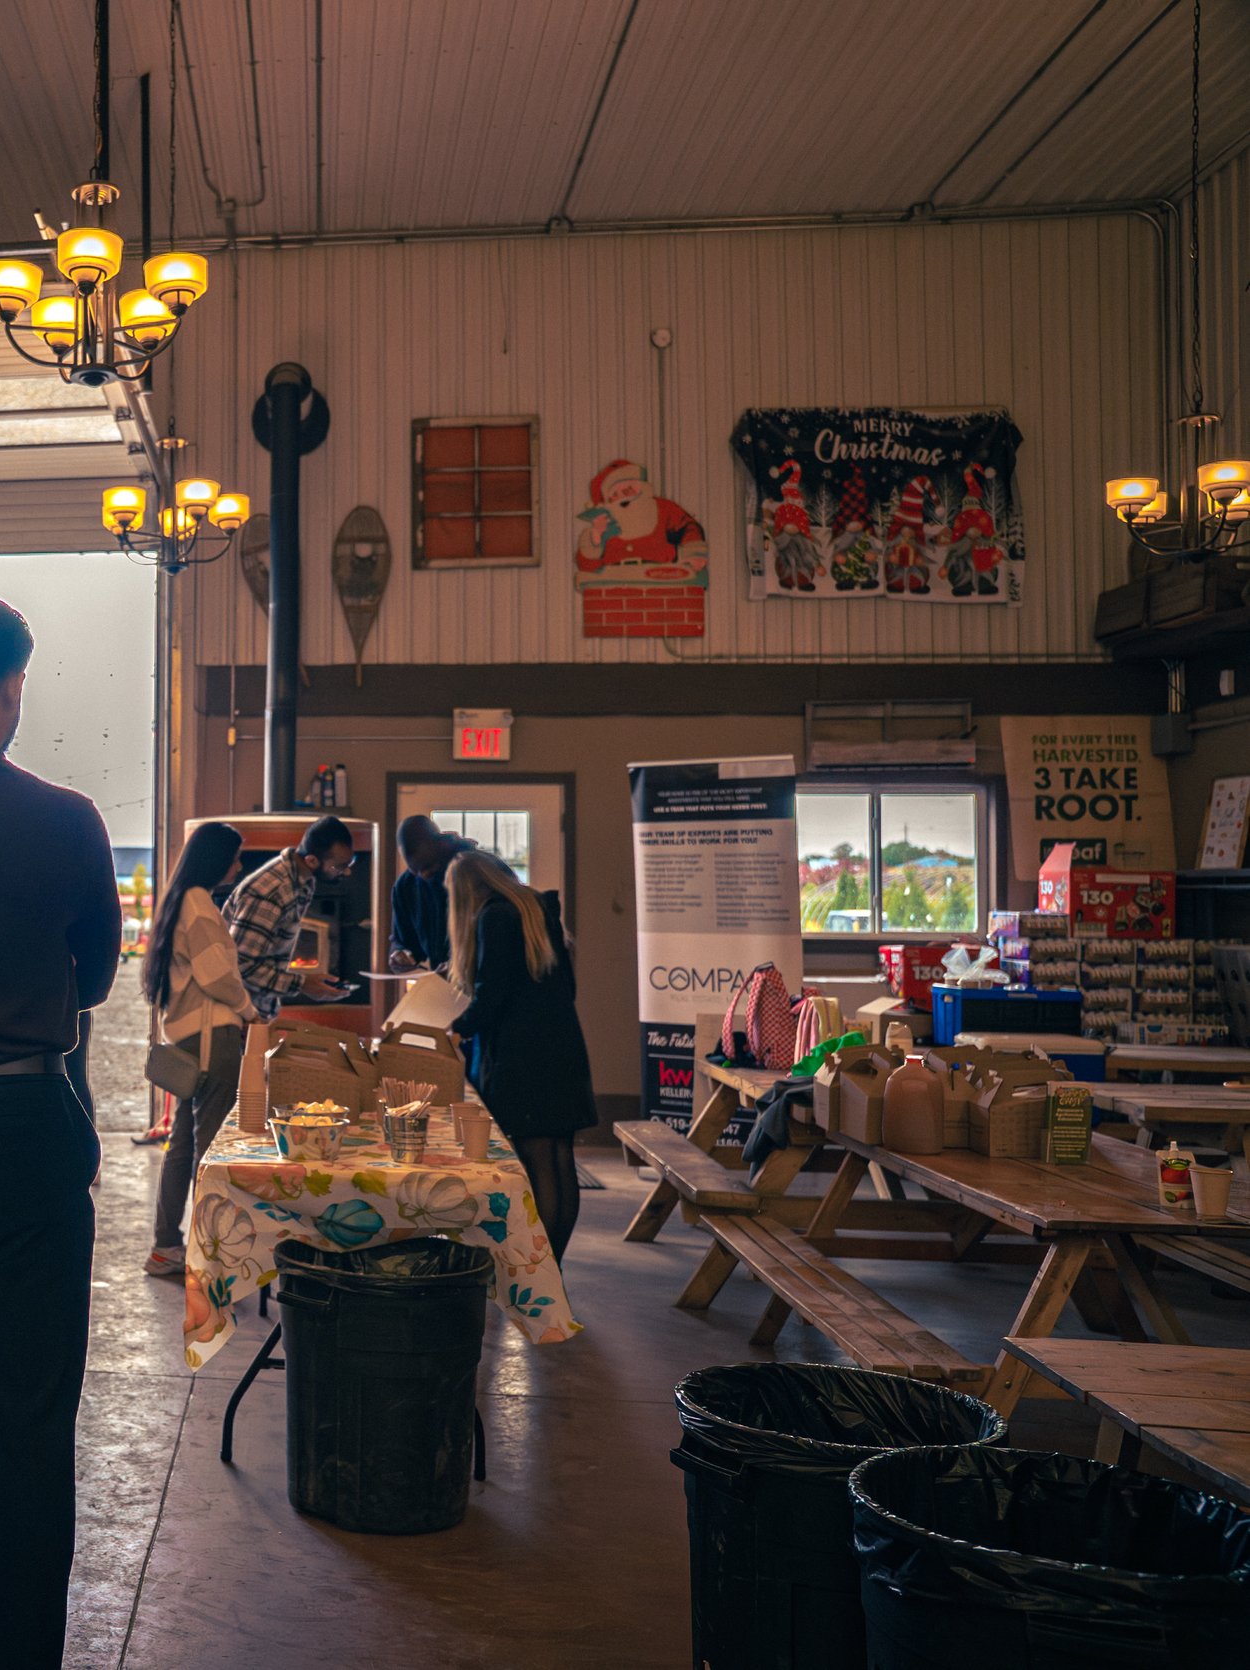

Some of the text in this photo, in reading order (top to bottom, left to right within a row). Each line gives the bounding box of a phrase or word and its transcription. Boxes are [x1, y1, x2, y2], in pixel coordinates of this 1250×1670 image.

[853, 418, 914, 437] MERRY
[814, 428, 946, 466] Christmas
[461, 727, 502, 757] EXIT
[1031, 734, 1137, 746] FOR EVERY TREE
[1034, 766, 1139, 790] 3 TAKE
[1035, 793, 1142, 822] ROOT.
[740, 828, 773, 836] PUTTING
[1040, 880, 1053, 895] 130
[1079, 890, 1114, 905] 130
[912, 965, 945, 980] 130
[648, 1031, 668, 1047] The
[659, 1060, 693, 1087] kw
[659, 1087, 693, 1099] KELLER
